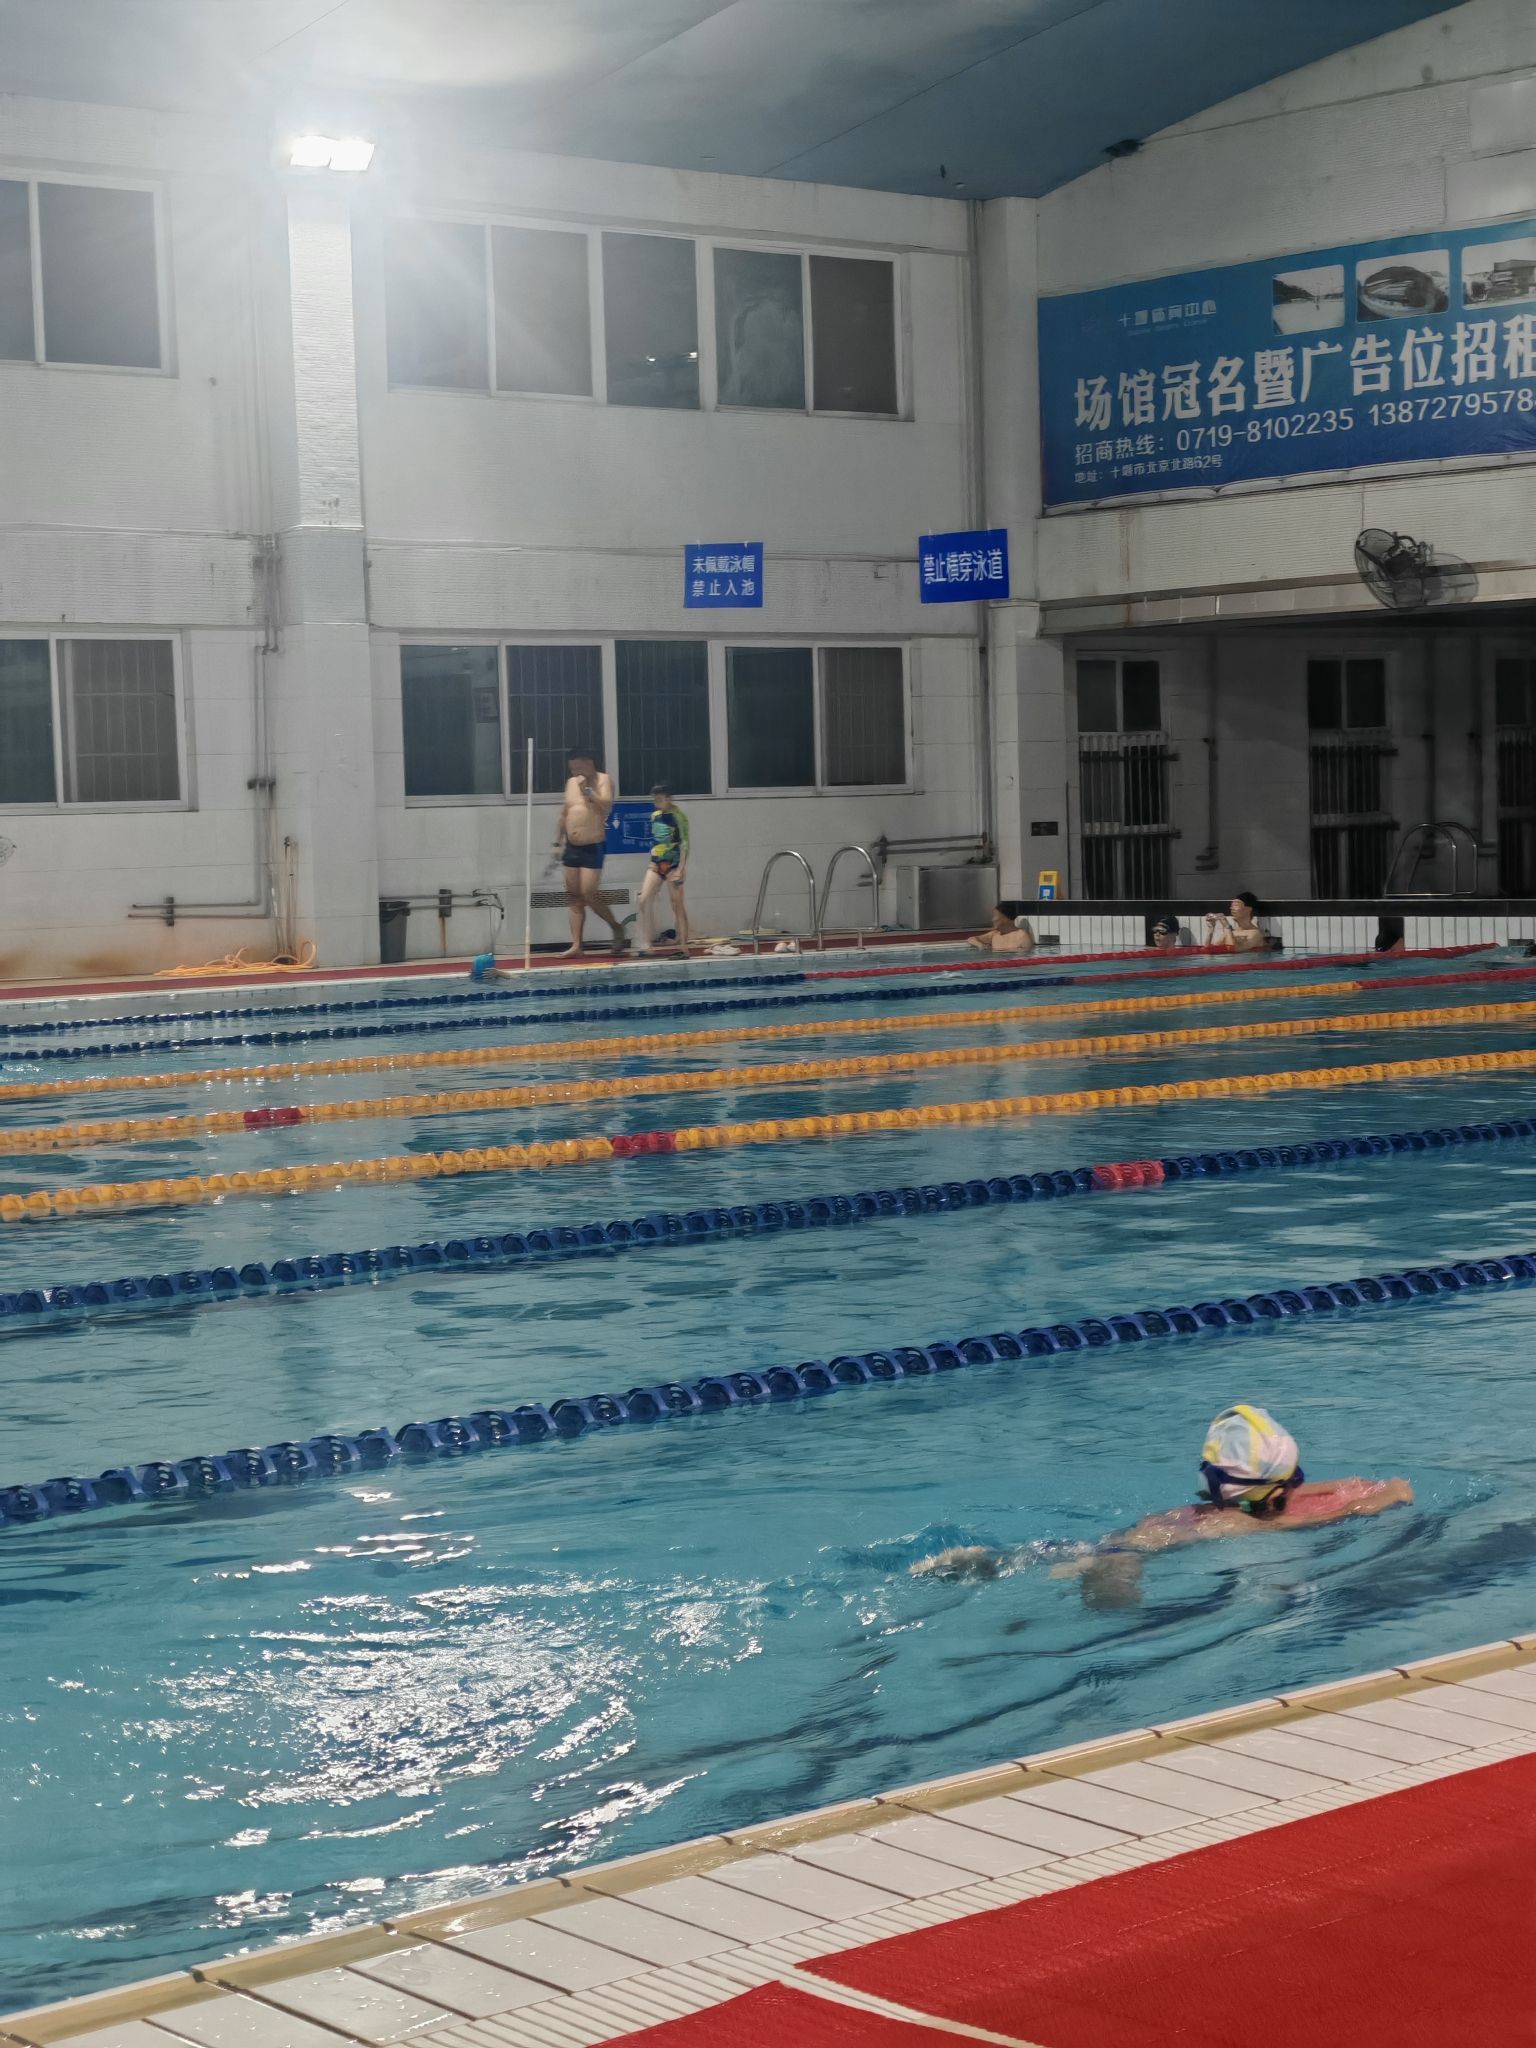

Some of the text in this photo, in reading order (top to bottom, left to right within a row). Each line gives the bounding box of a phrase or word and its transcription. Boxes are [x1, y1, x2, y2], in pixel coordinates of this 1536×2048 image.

[1074, 314, 1536, 432] 场馆冠名暨广告位招租
[1176, 408, 1354, 451] 0719-8102235
[923, 548, 1004, 585] 禁止横穿泳道
[691, 578, 755, 597] 禁止入池
